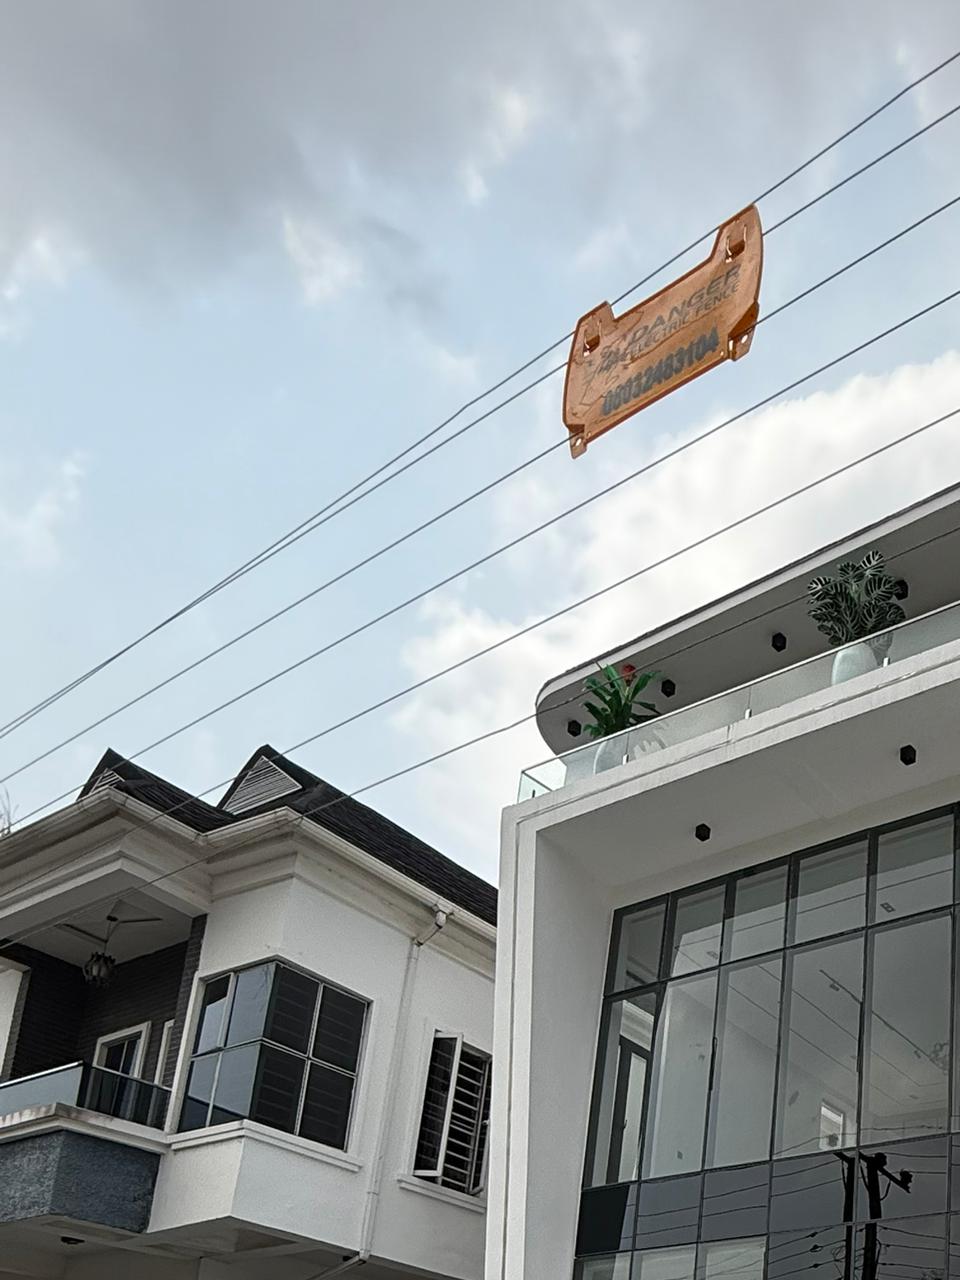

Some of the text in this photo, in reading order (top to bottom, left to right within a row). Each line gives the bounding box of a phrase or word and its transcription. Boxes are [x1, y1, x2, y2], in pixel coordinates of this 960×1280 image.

[631, 281, 739, 357] ELECTRIC FENCE
[632, 263, 741, 344] DANGER
